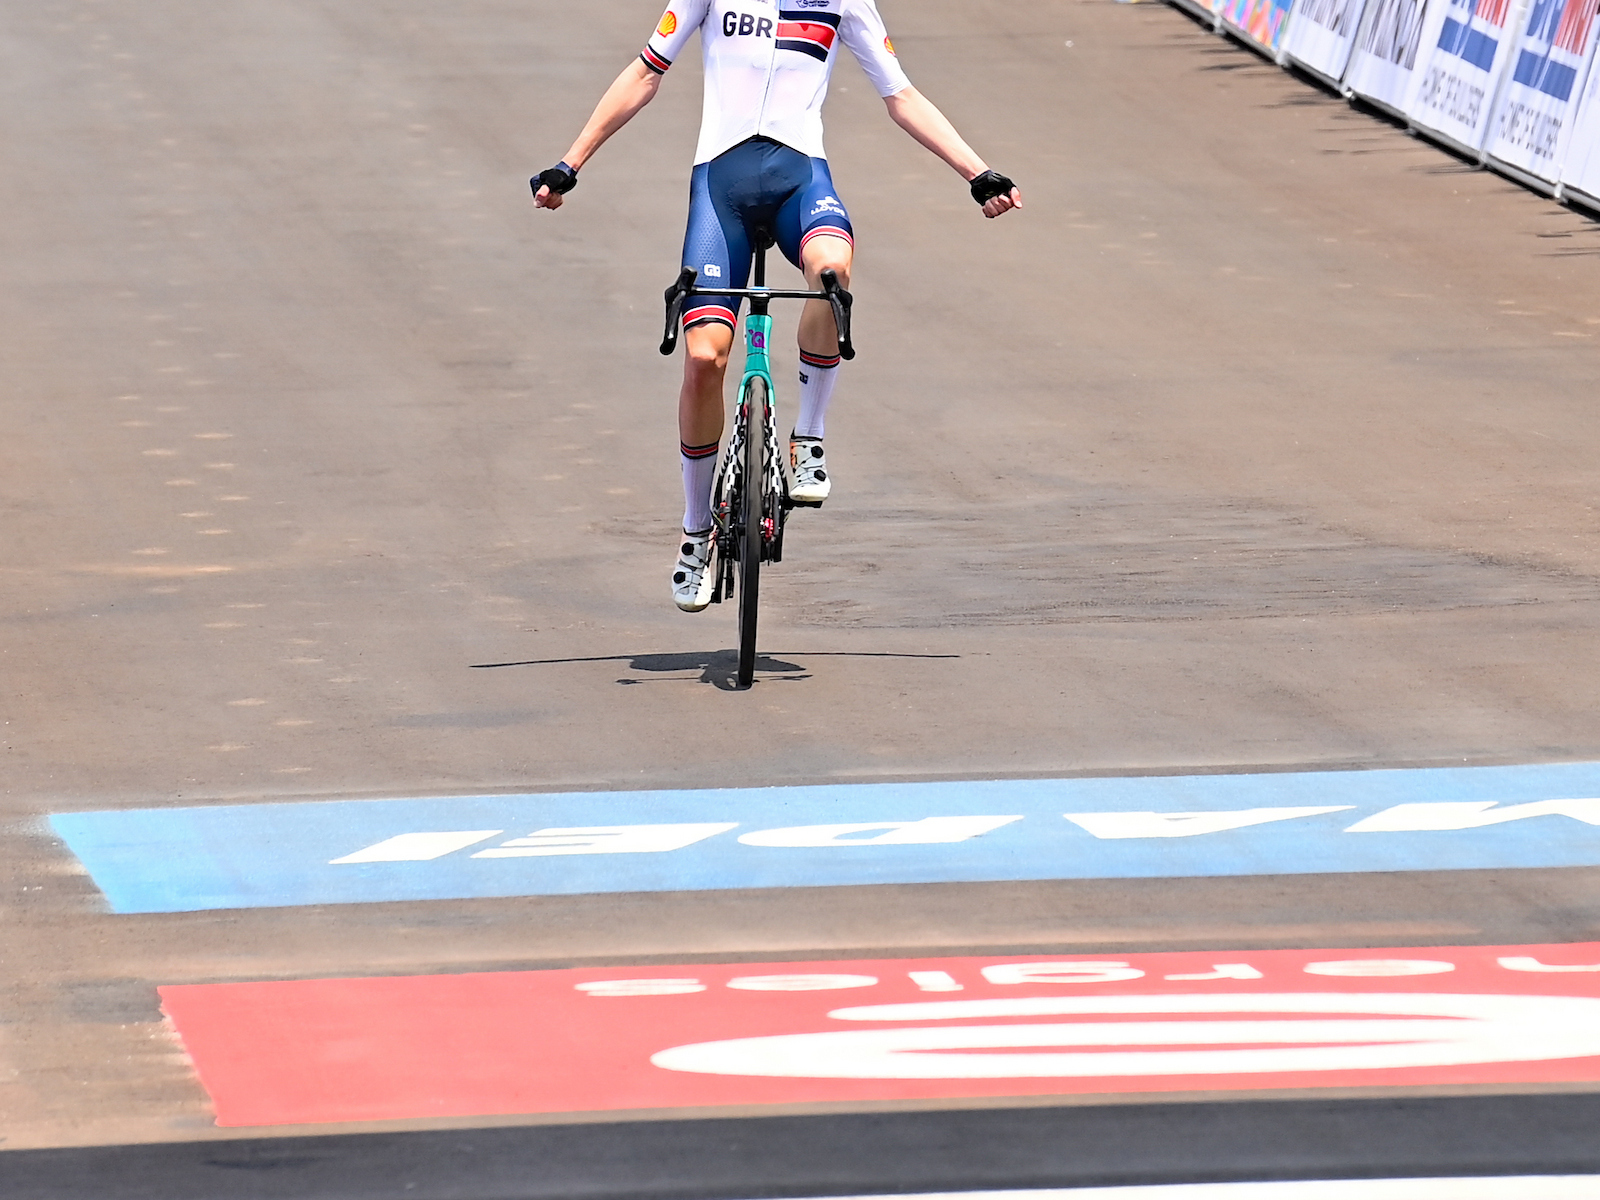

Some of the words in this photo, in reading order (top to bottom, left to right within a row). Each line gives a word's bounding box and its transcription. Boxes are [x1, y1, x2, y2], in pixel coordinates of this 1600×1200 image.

[723, 11, 773, 38] GBR
[810, 200, 846, 217] LLOYDS
[327, 798, 1600, 864] MAPEI
